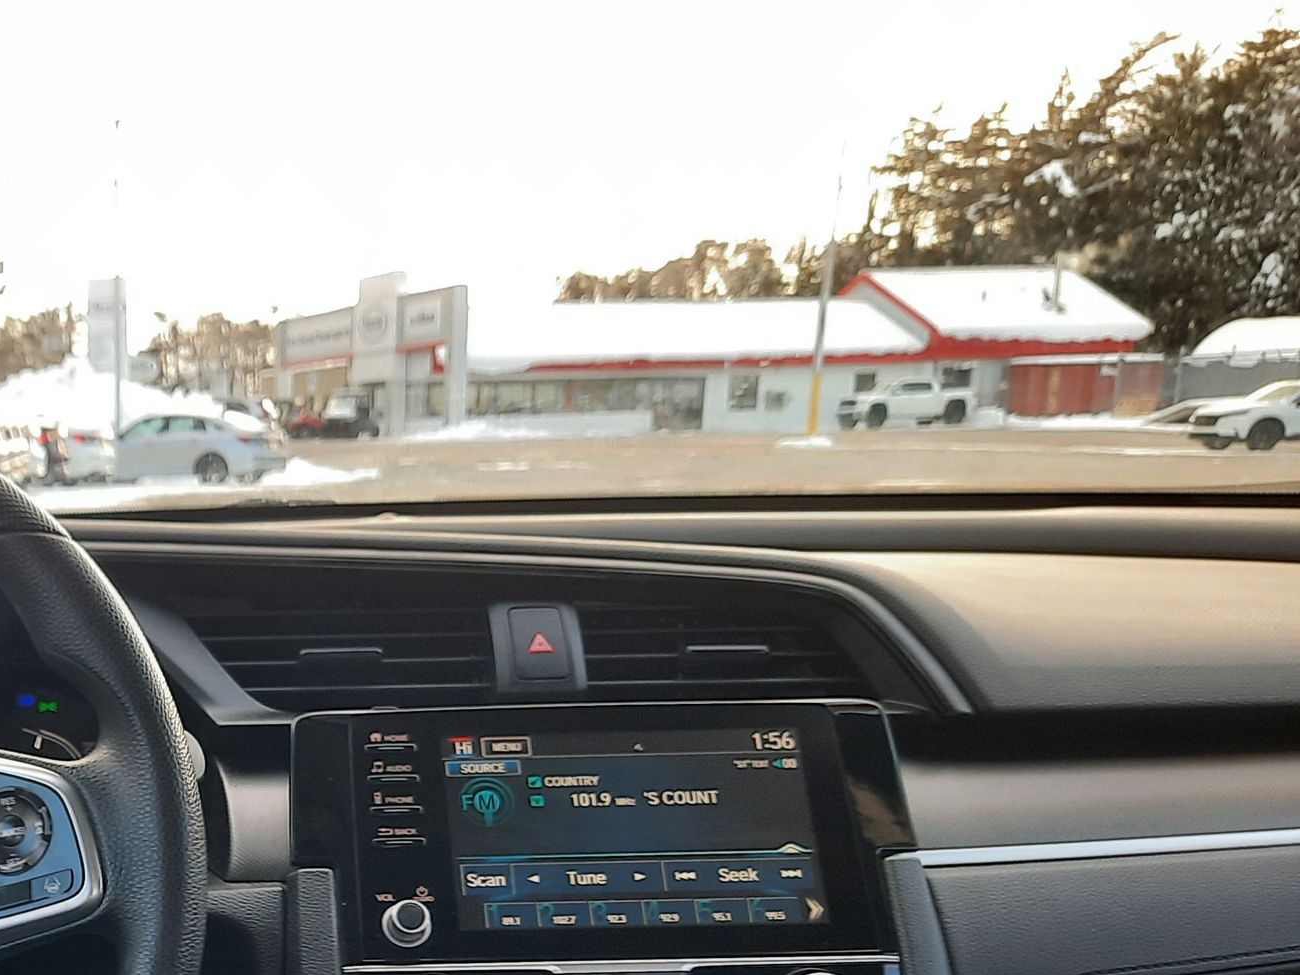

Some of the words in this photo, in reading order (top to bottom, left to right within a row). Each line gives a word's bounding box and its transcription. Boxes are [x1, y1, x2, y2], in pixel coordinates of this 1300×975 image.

[384, 734, 409, 742] HOME
[491, 742, 523, 752] MENU
[751, 731, 796, 750] 1:56
[385, 765, 413, 773] AUDIO
[460, 763, 508, 774] SOURCE
[544, 775, 599, 788] COUNTRY
[385, 796, 415, 804] PHONE
[570, 792, 611, 807] 101.9
[661, 789, 720, 805] COUNT
[394, 828, 419, 836] BACK
[465, 872, 507, 888] Scan
[565, 870, 608, 886] Tune
[717, 867, 760, 883] Seek
